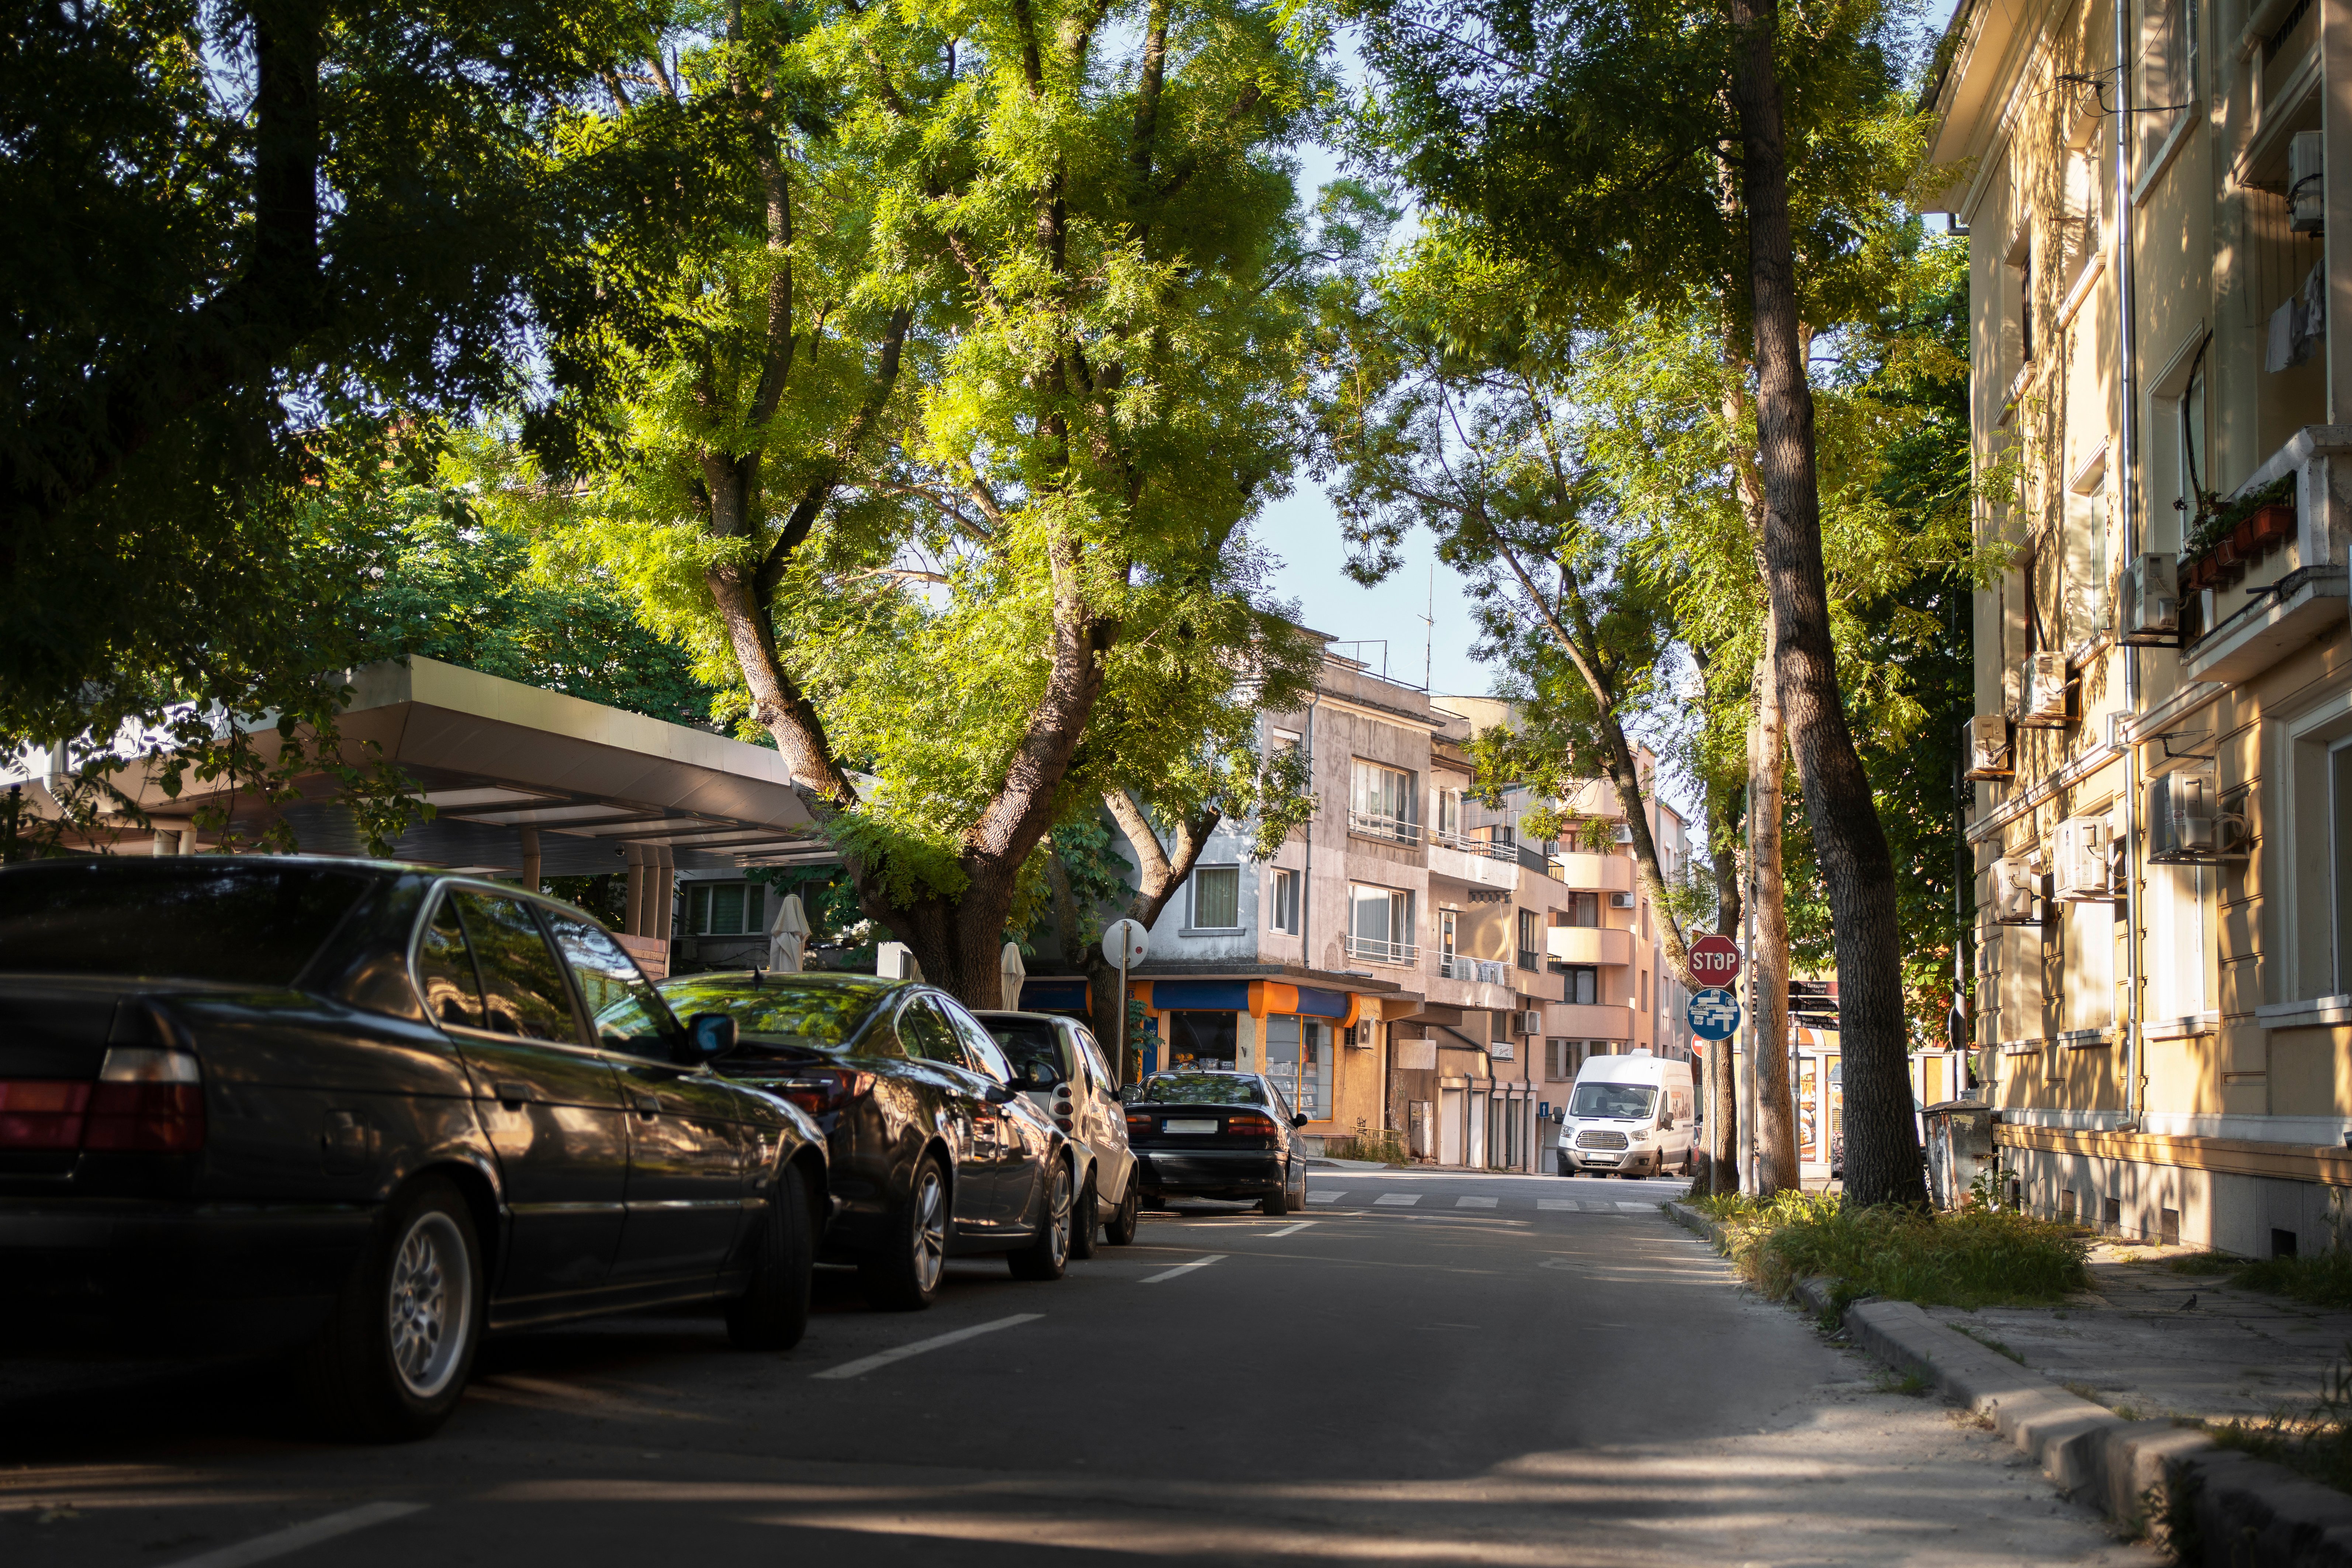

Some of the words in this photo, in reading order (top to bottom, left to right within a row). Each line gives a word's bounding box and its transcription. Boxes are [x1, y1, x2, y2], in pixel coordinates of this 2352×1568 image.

[632, 948, 650, 959] РИМСКИ
[651, 952, 664, 961] ТЕРМИ
[1693, 952, 1736, 970] STOP
[647, 963, 663, 973] БИСТРО
